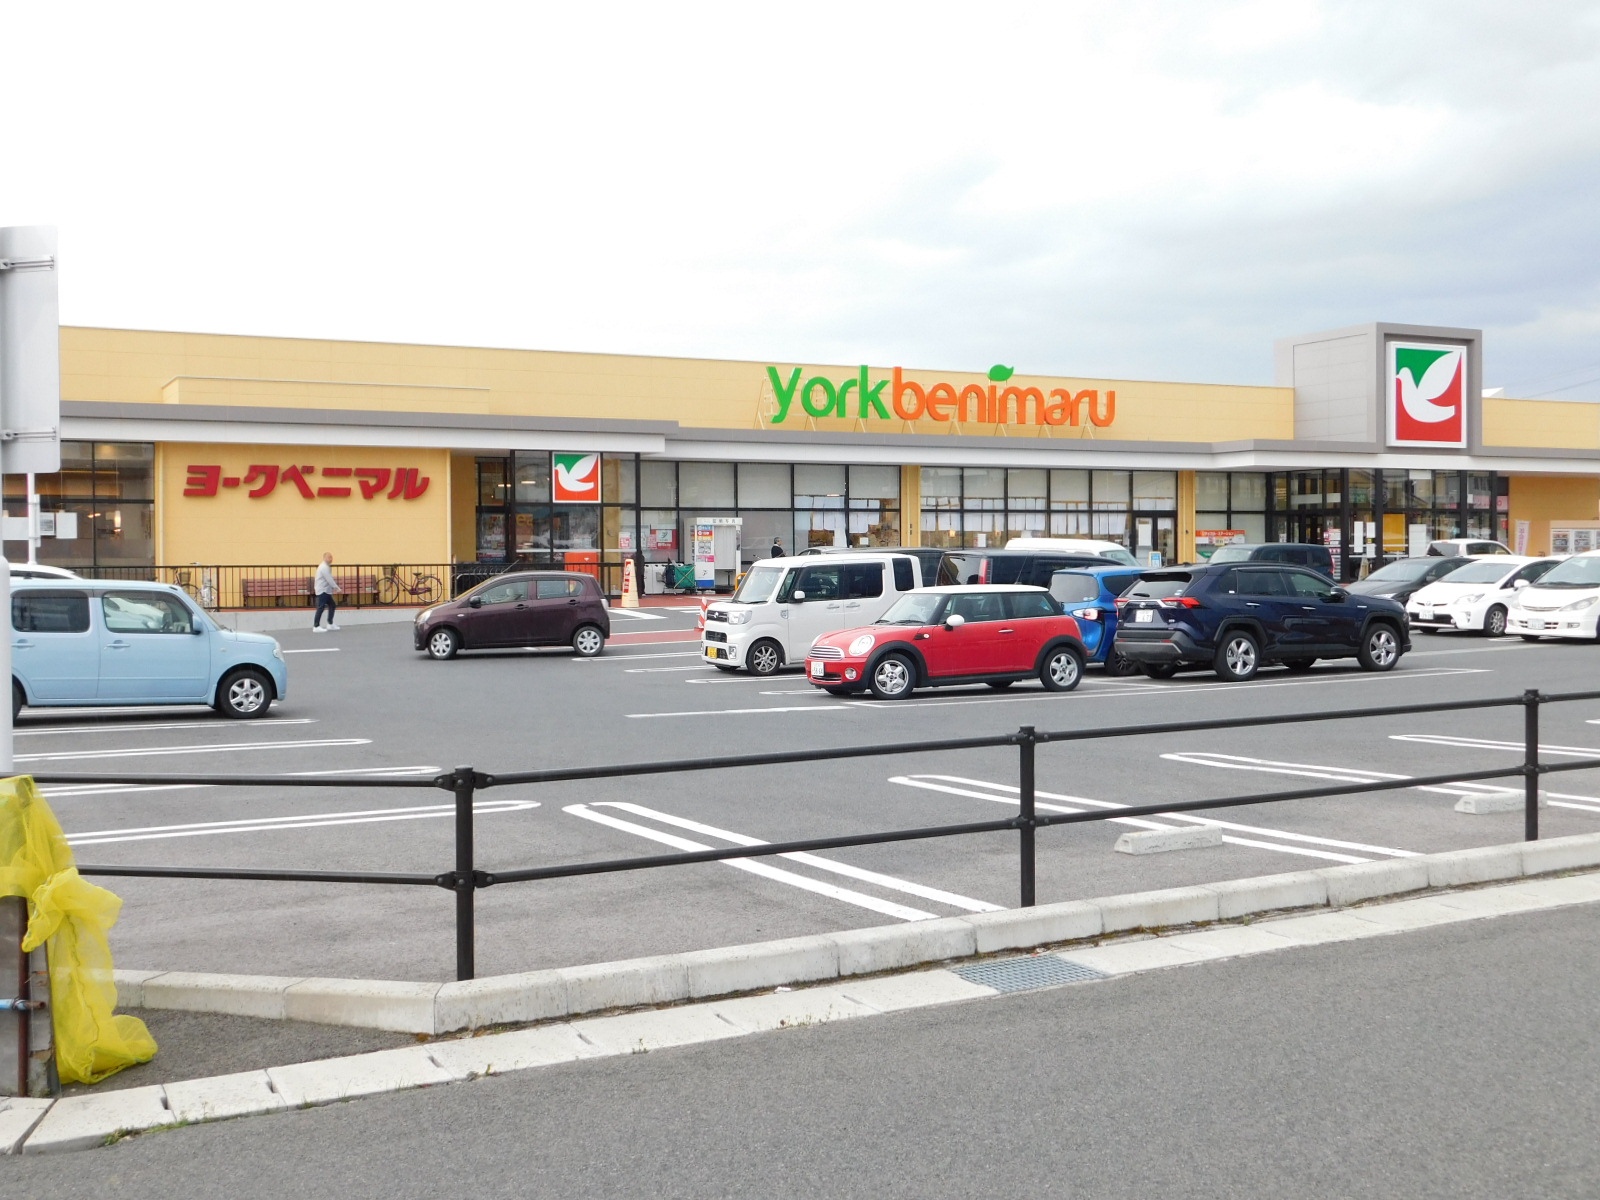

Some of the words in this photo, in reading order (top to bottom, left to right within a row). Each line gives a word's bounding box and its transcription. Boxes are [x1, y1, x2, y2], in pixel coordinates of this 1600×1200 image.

[183, 464, 430, 500] ヨークベニマル
